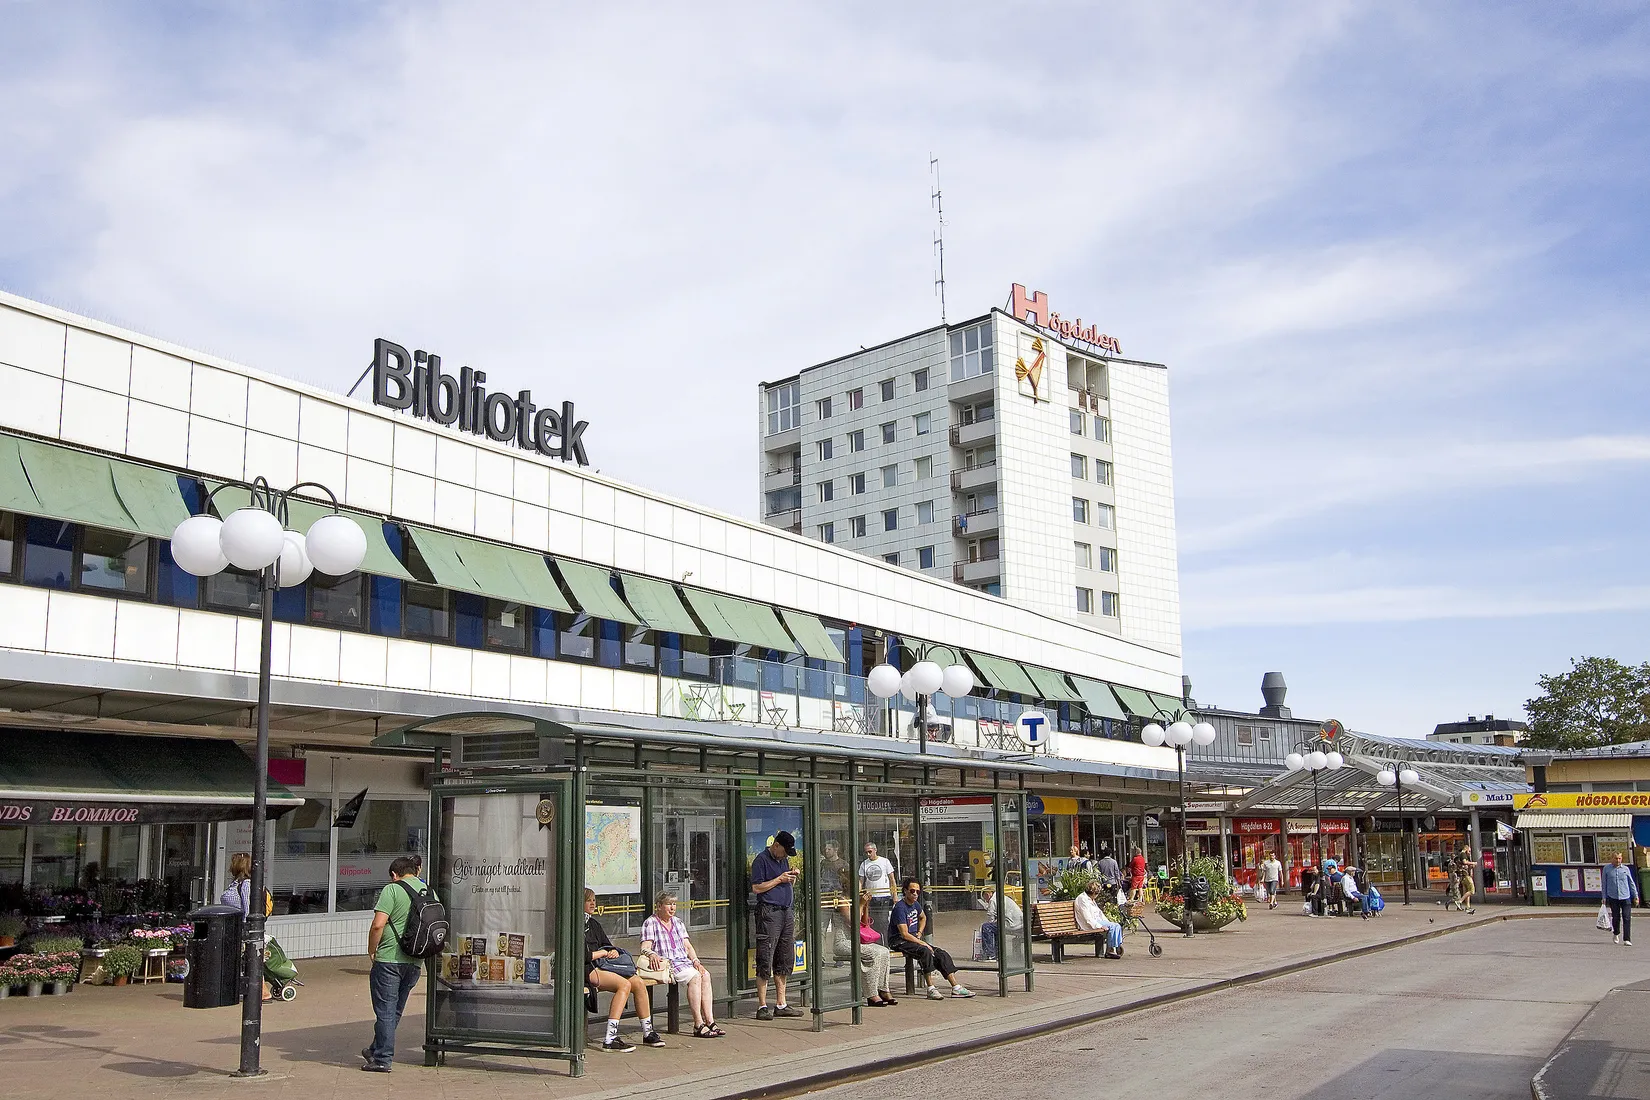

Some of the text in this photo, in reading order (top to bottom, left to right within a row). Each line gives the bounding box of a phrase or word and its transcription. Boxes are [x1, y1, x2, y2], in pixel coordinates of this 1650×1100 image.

[1012, 283, 1122, 354] Högdalen
[373, 338, 589, 466] Bibliotek
[1022, 718, 1045, 741] T
[51, 807, 139, 821] BLOMMOR
[921, 806, 933, 814] 165
[1007, 798, 1016, 809] A
[452, 858, 545, 884] Gör något radikalt!
